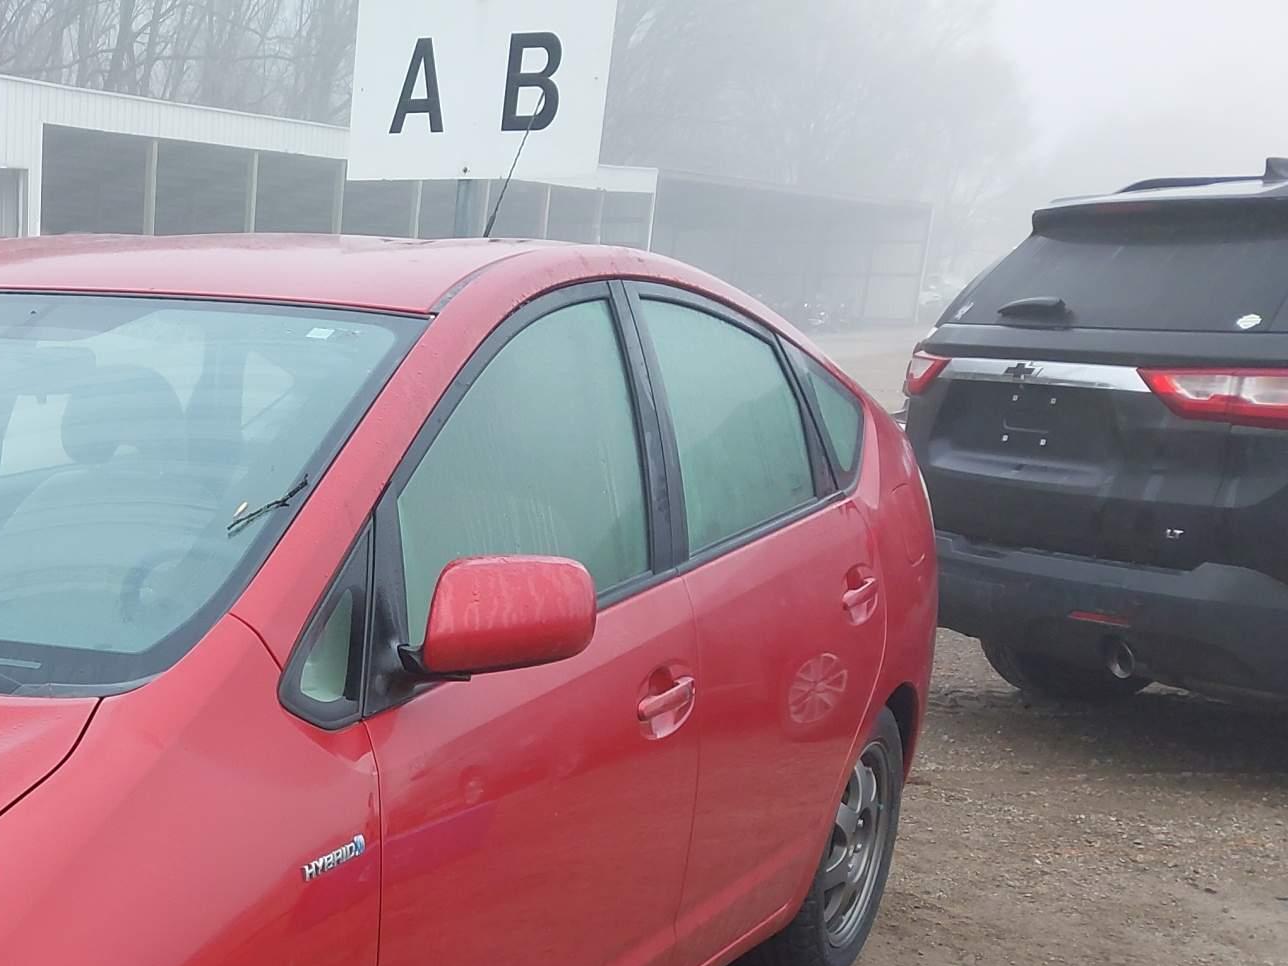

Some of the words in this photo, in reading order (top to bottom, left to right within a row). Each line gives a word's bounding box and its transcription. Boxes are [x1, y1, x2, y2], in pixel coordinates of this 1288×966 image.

[389, 37, 443, 133] A
[501, 32, 562, 132] B
[1166, 529, 1184, 540] LT
[302, 842, 356, 882] HYBRID
